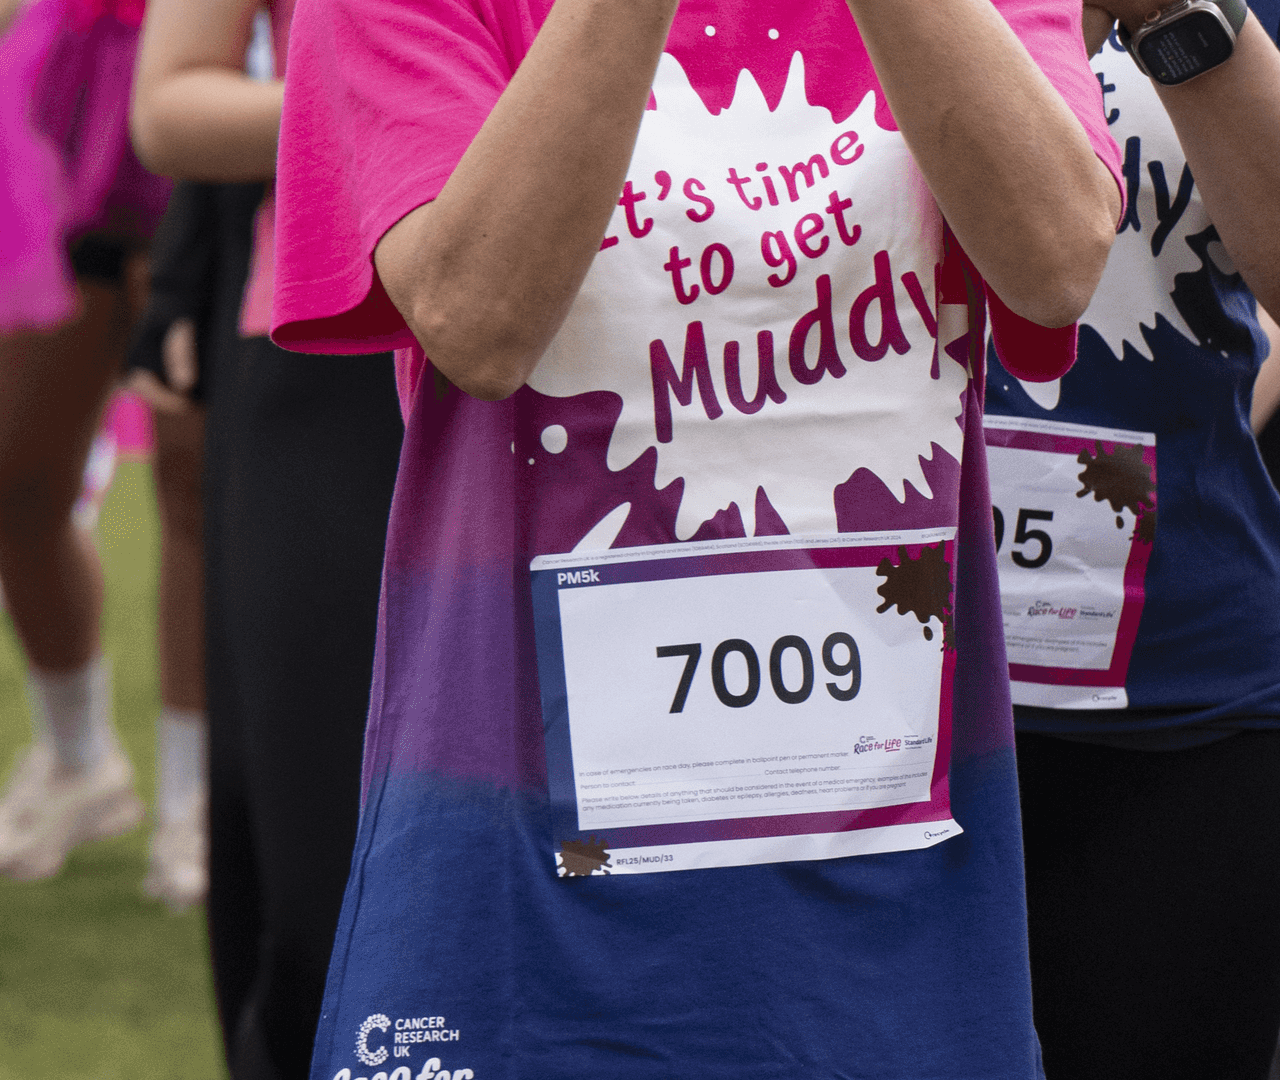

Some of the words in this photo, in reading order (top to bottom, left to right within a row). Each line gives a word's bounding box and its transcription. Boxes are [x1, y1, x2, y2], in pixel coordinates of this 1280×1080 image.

[600, 170, 715, 252] t's
[726, 130, 865, 211] time
[664, 243, 735, 306] to
[761, 190, 862, 289] get
[557, 569, 601, 586] PM5k
[656, 631, 863, 715] 7009
[854, 742, 874, 755] Race
[884, 738, 902, 750] Life
[616, 853, 674, 867] RFL25/MUD/33
[394, 1016, 446, 1031] CANCER
[394, 1029, 460, 1044] RESEARCH
[393, 1045, 410, 1058] UK
